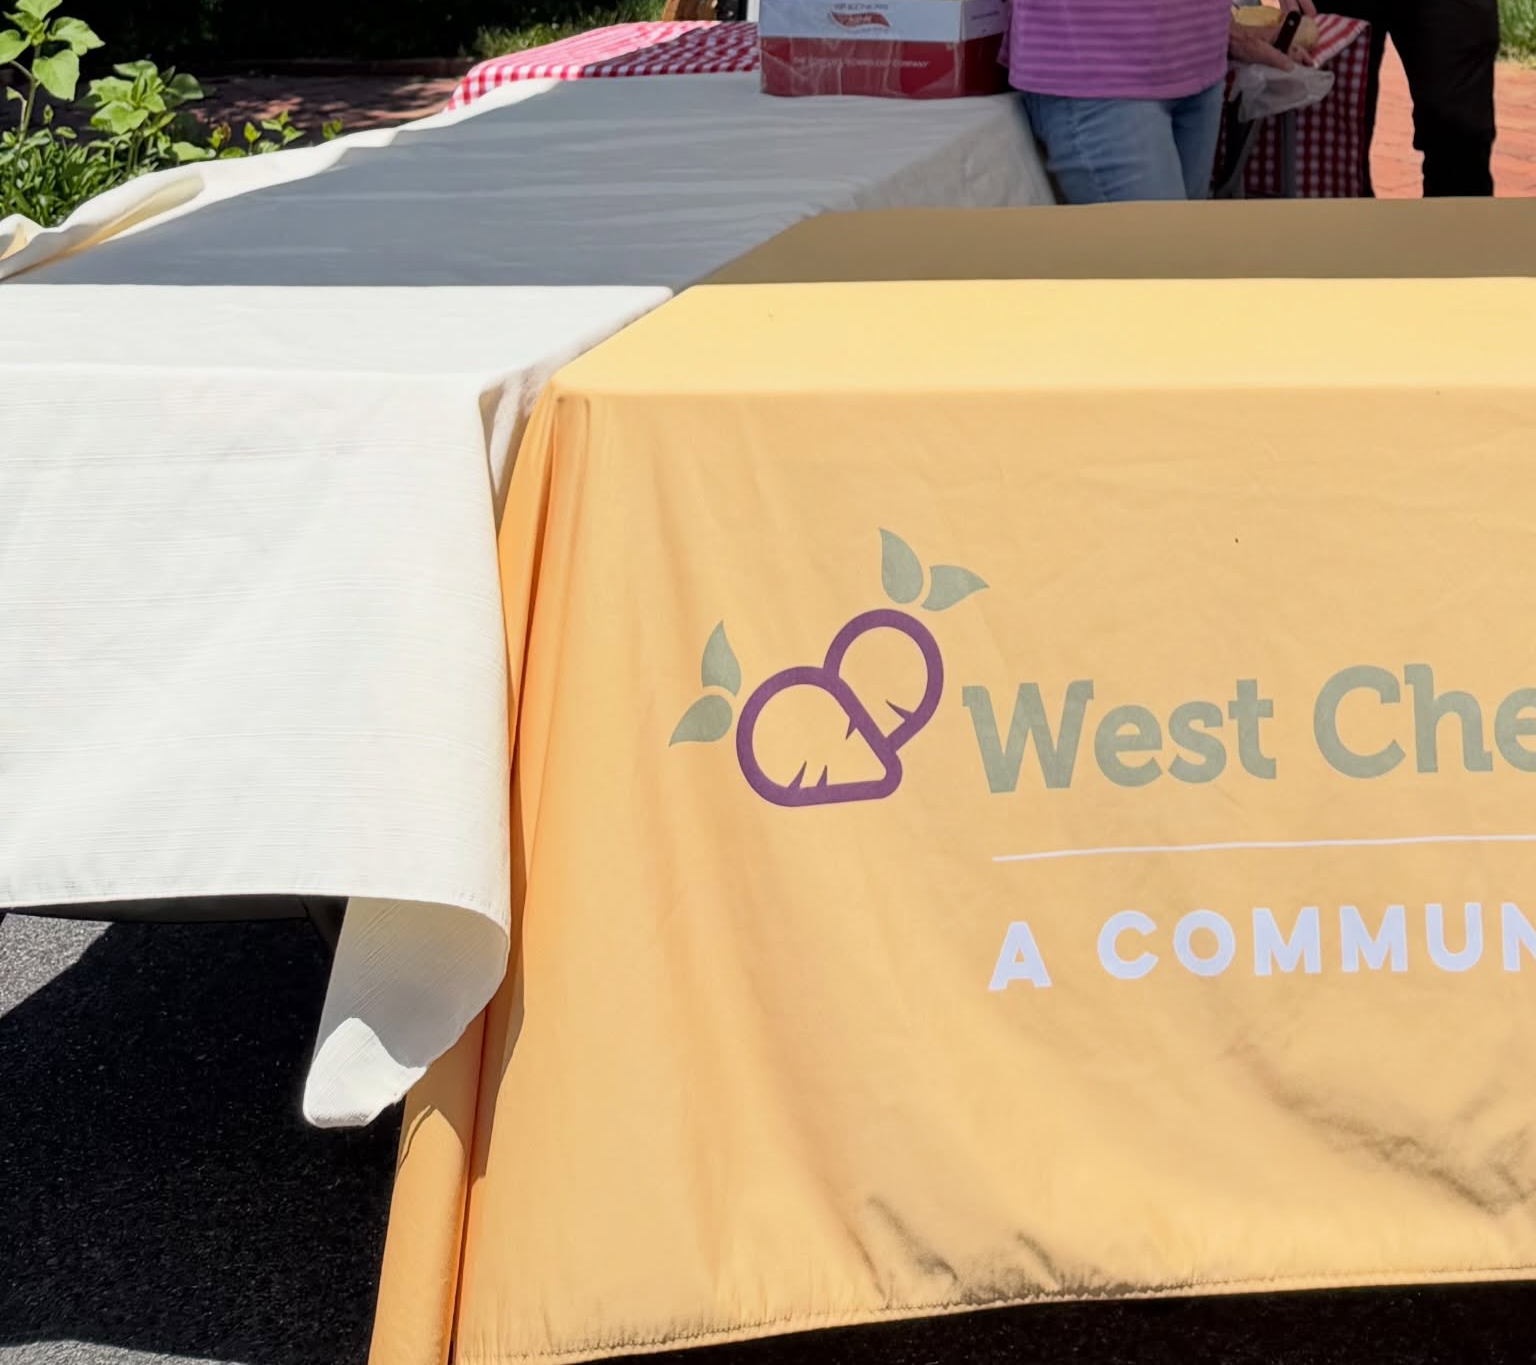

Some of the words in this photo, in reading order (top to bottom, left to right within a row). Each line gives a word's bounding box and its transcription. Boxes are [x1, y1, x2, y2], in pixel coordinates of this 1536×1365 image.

[892, 59, 930, 68] COMPANY
[961, 678, 1277, 794] West
[988, 920, 1052, 991] A
